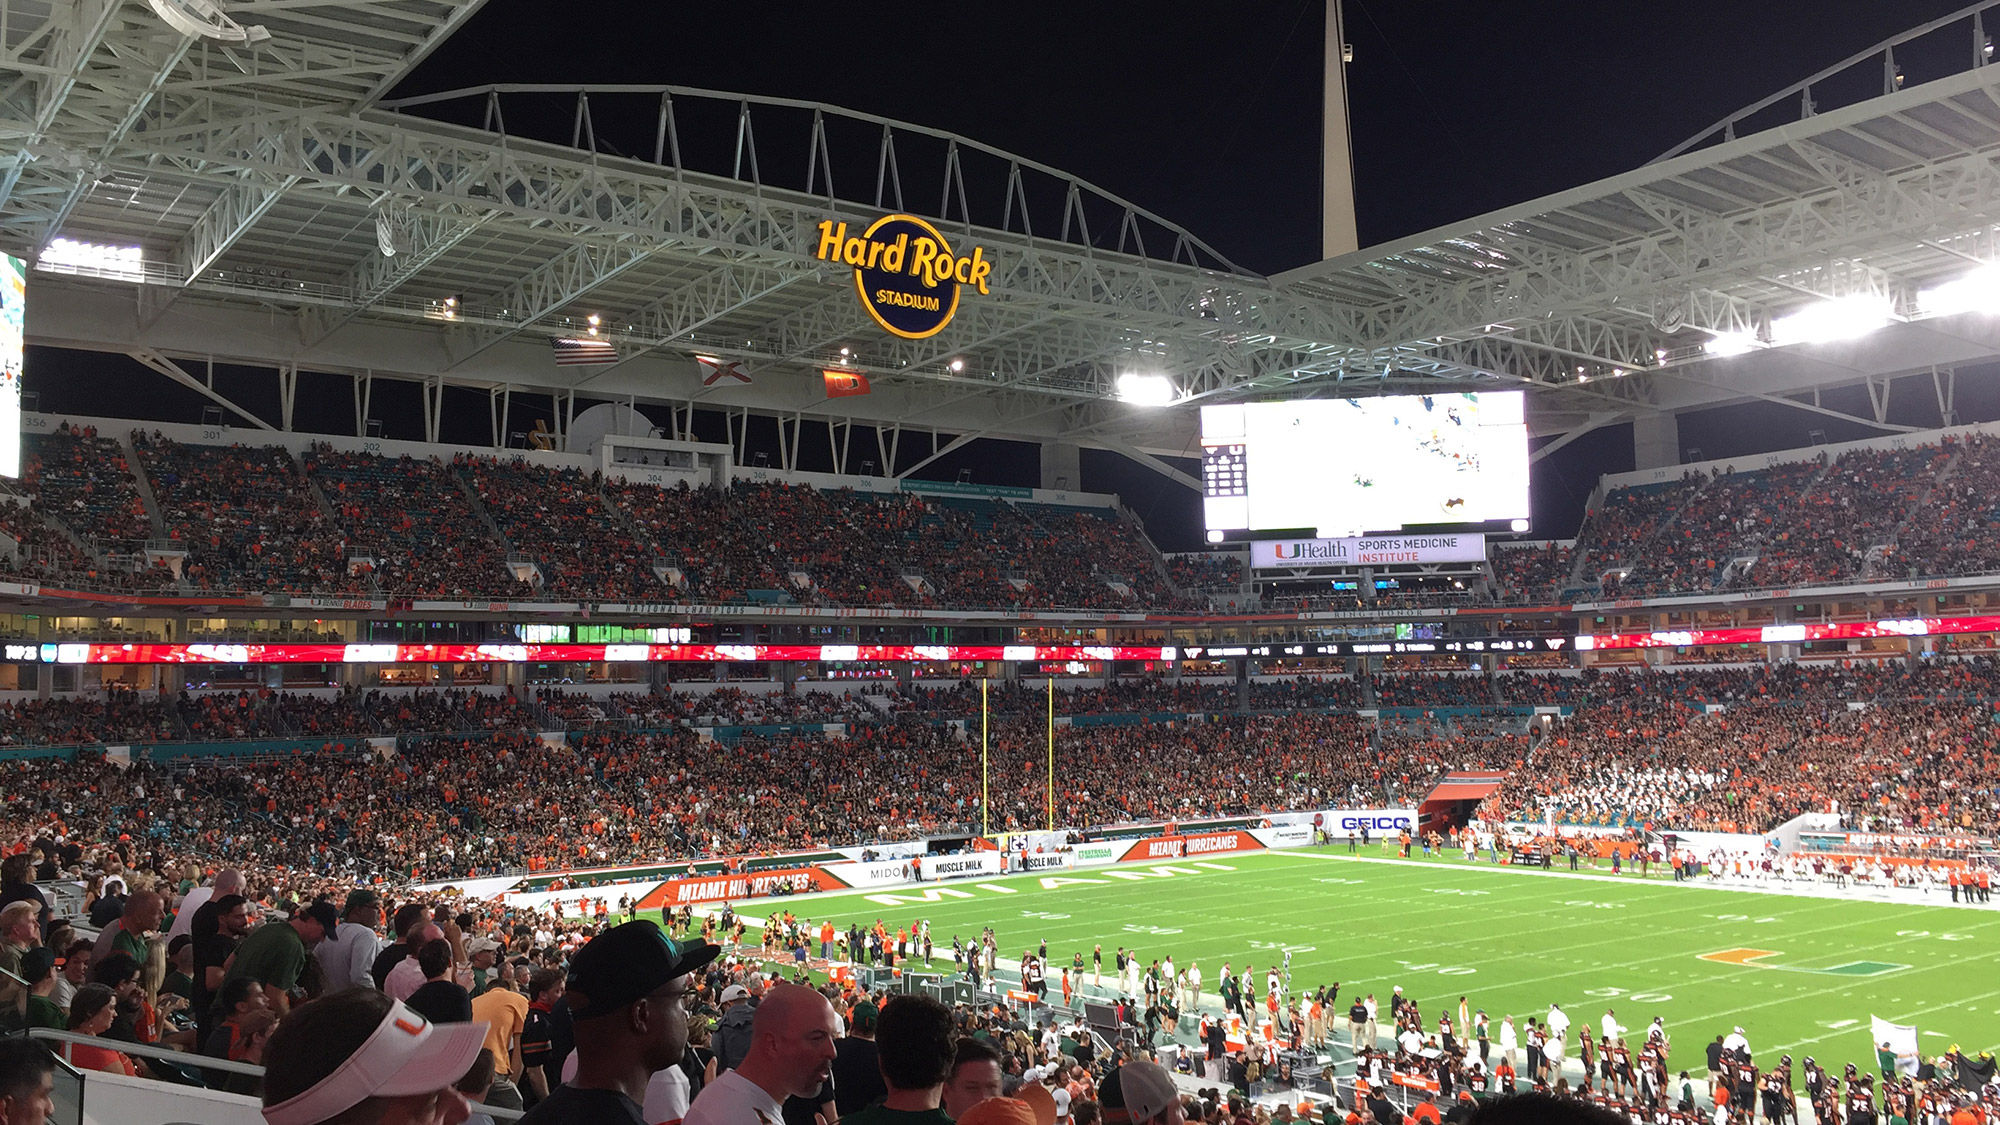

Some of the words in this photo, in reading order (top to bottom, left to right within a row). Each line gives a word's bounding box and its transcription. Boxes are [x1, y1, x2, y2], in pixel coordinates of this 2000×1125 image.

[816, 219, 909, 273] Hard
[910, 237, 992, 295] Rock
[876, 289, 940, 312] STADIUM
[25, 417, 46, 427] 356
[203, 430, 221, 440] 301
[364, 442, 380, 451] 302
[648, 474, 662, 482] 304
[1275, 541, 1347, 559] UHealth
[1358, 540, 1401, 551] SPORTS
[1404, 538, 1458, 548] MEDICINE
[1358, 552, 1419, 562] INSTITUTE
[343, 600, 372, 609] BLADES
[626, 604, 678, 614] NATIONAL
[684, 605, 745, 614] CHAMPIONS
[1334, 610, 1367, 618] RING
[1342, 817, 1410, 830] GEICO
[1149, 840, 1182, 857] MIAMI
[935, 861, 963, 873] MUSCLE
[965, 859, 983, 870] MILK
[1046, 856, 1063, 866] MILK
[870, 867, 900, 879] MIDO
[677, 880, 728, 902] MIAMI
